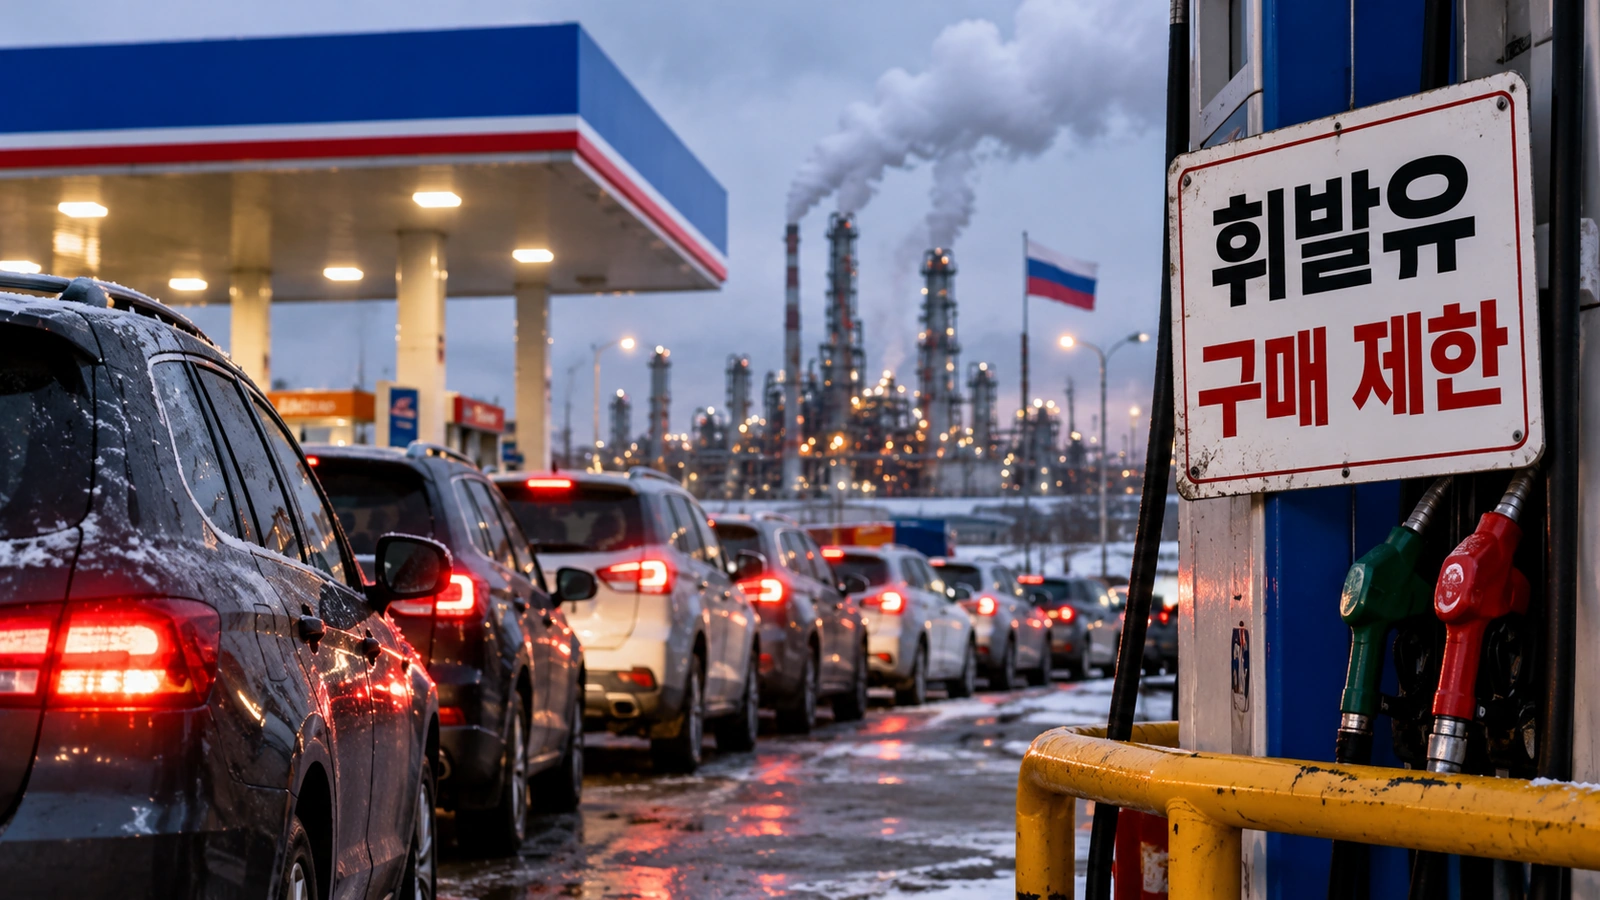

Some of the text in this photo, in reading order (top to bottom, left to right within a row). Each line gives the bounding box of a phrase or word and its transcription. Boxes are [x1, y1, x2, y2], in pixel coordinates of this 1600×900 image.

[1211, 154, 1476, 308] 휘발유
[1198, 298, 1508, 438] 구매 제한
